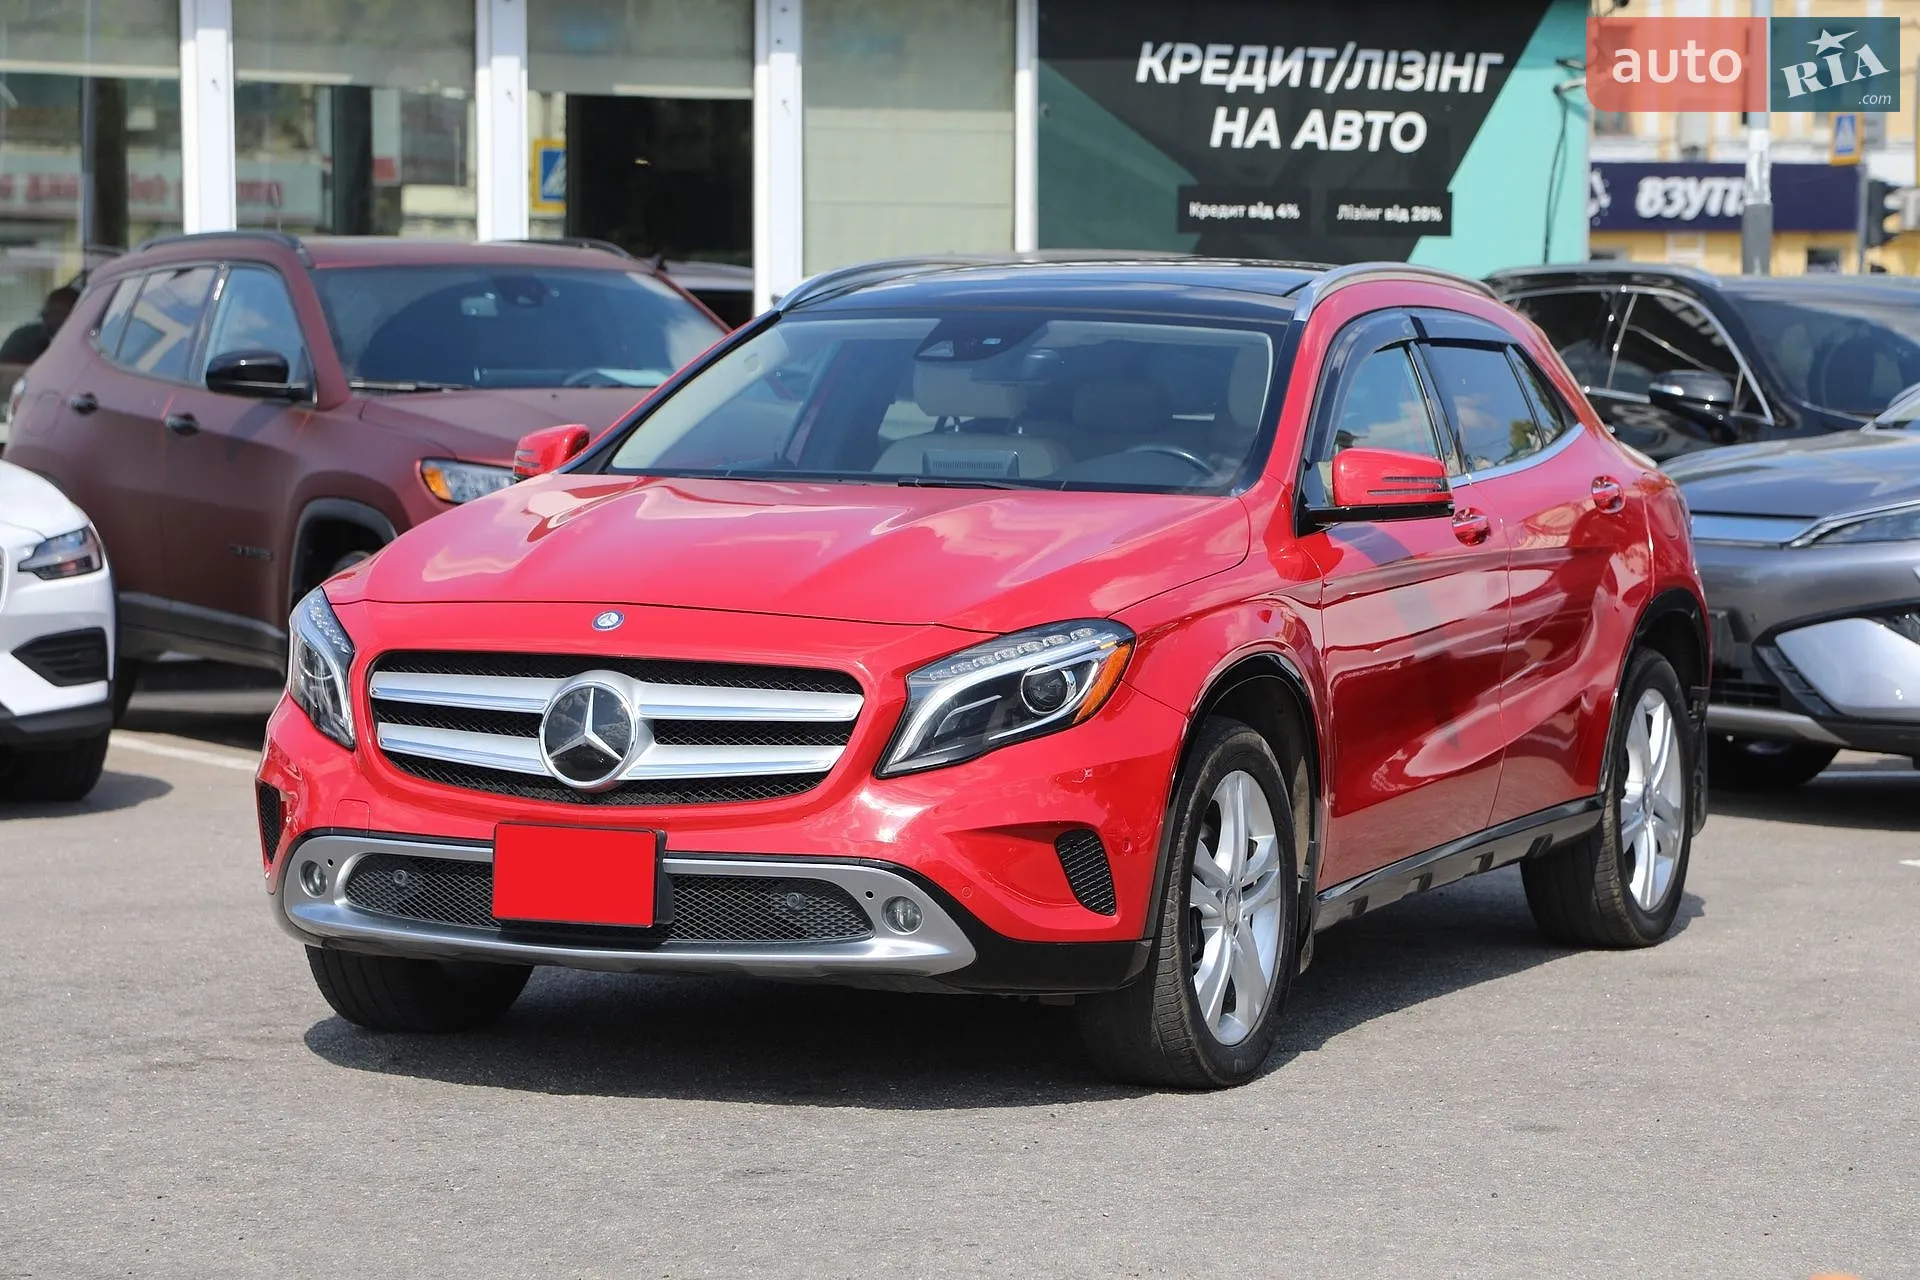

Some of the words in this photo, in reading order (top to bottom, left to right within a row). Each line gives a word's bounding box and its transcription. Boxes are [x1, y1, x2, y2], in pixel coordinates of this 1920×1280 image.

[1136, 42, 1504, 93] КРЕДИТ/ЛІЗІНГ
[1210, 107, 1281, 149] НА
[1291, 108, 1427, 154] АВТО
[1189, 200, 1246, 220] Кредит
[1248, 200, 1274, 220] від
[1275, 202, 1300, 220] 4%
